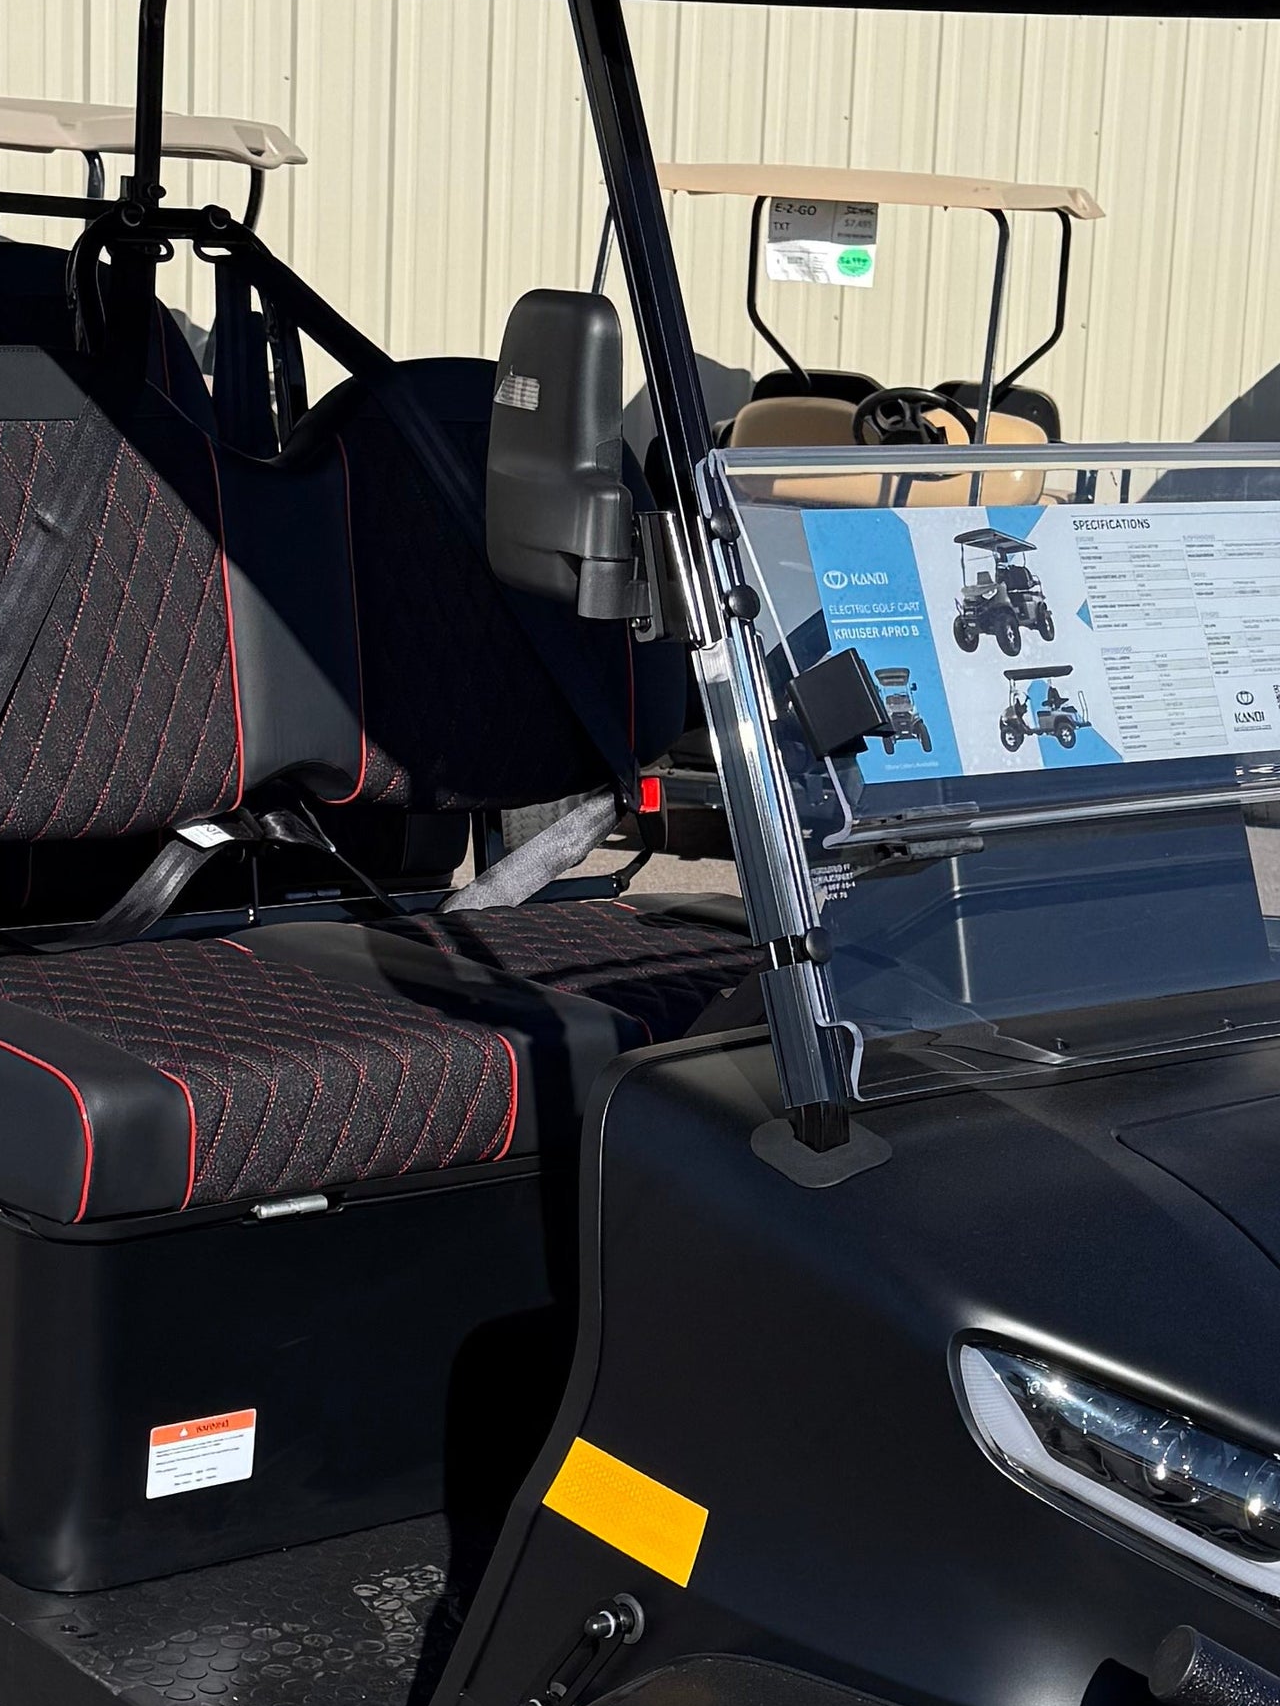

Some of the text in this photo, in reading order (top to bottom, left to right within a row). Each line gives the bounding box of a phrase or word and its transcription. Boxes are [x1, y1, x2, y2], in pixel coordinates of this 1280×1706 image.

[1072, 518, 1151, 531] SPECIFICATIONS
[850, 571, 889, 587] KANDI
[828, 601, 921, 616] ELECTRIC GOLF CART
[833, 626, 879, 641] KRUISER
[881, 625, 910, 638] 4PRO
